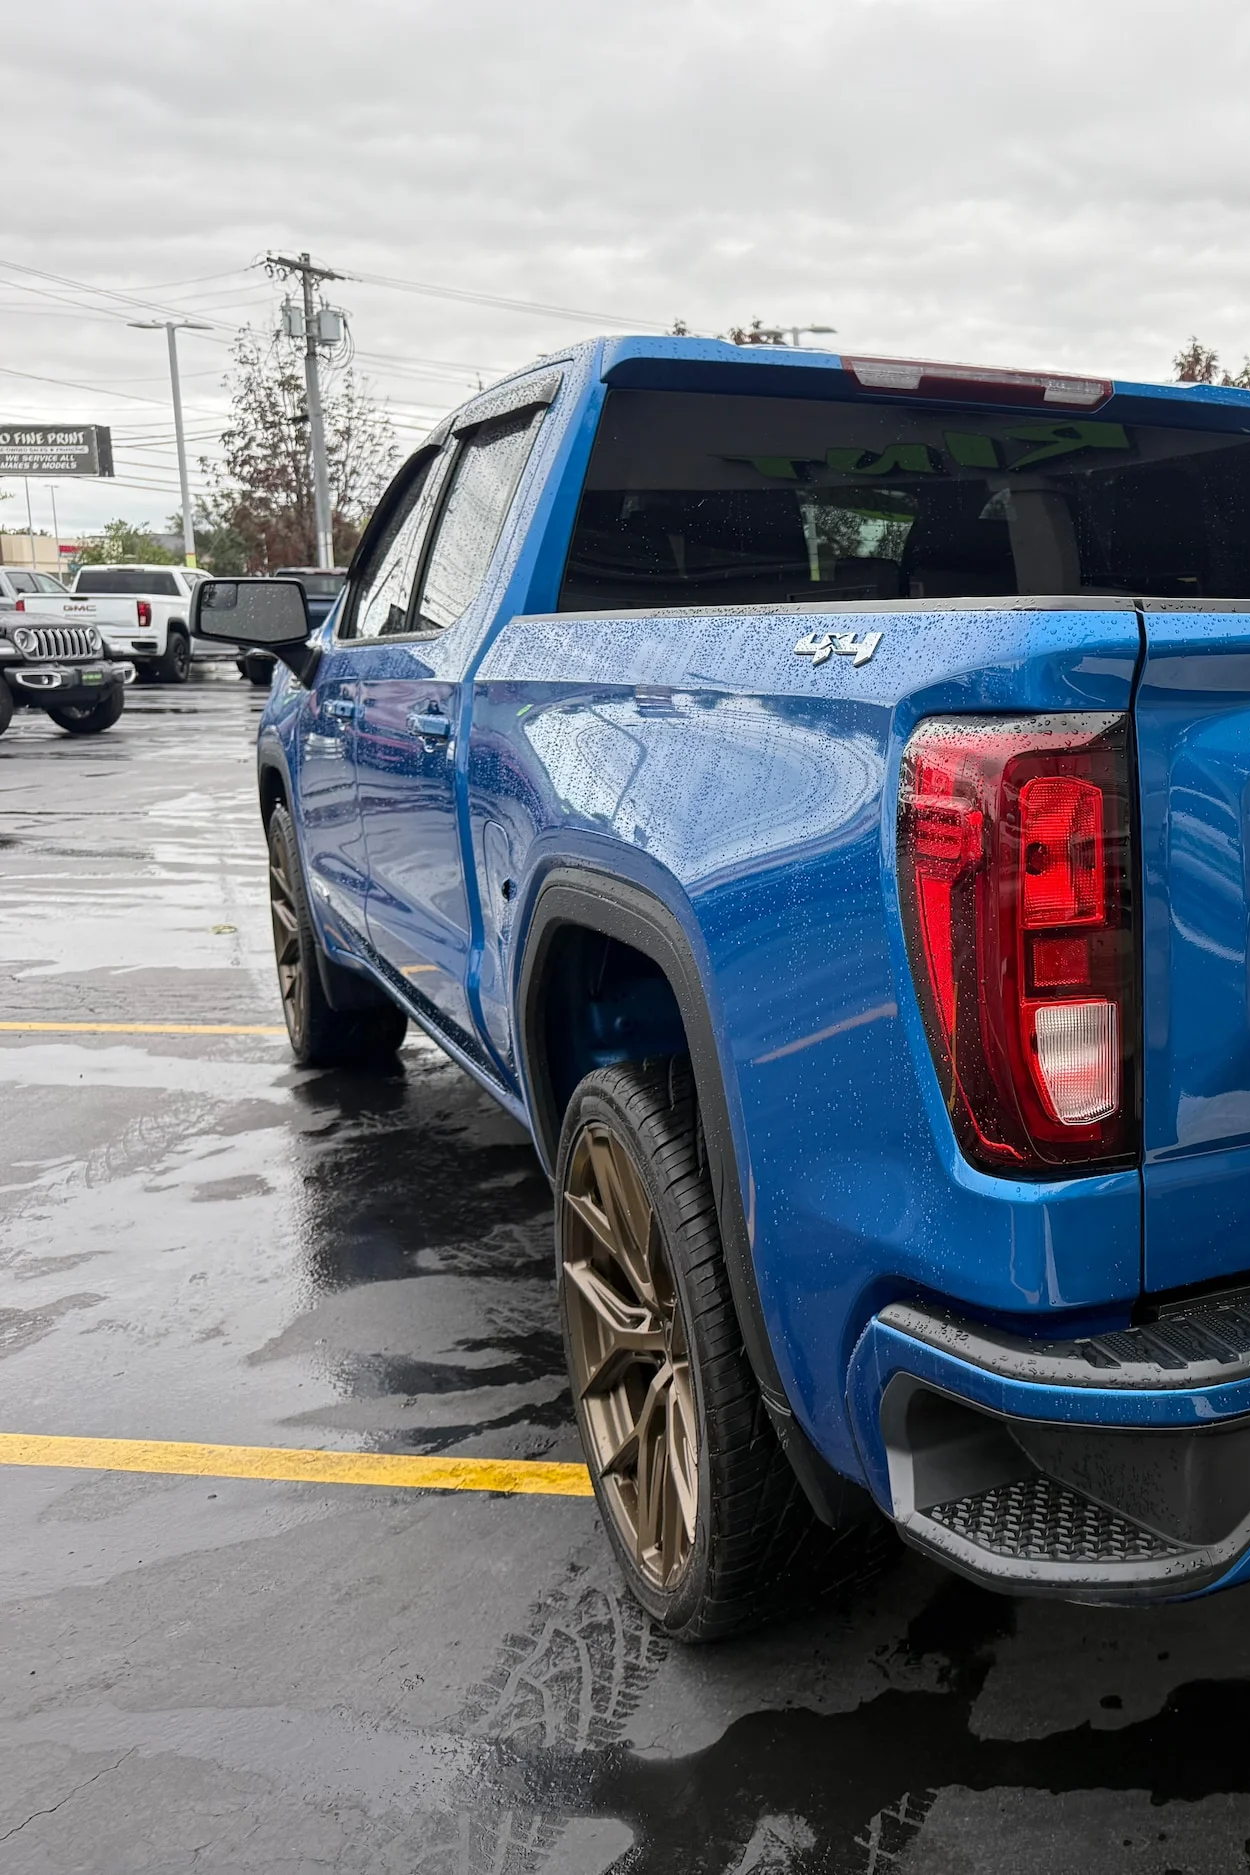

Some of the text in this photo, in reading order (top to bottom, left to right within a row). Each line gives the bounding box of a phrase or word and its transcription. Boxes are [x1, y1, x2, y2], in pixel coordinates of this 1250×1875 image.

[13, 431, 44, 444] FINE
[47, 431, 84, 444] PRINT
[6, 454, 75, 462] WE SERVICE ALL
[1, 461, 30, 469] MAKES
[42, 461, 77, 469] MODELS
